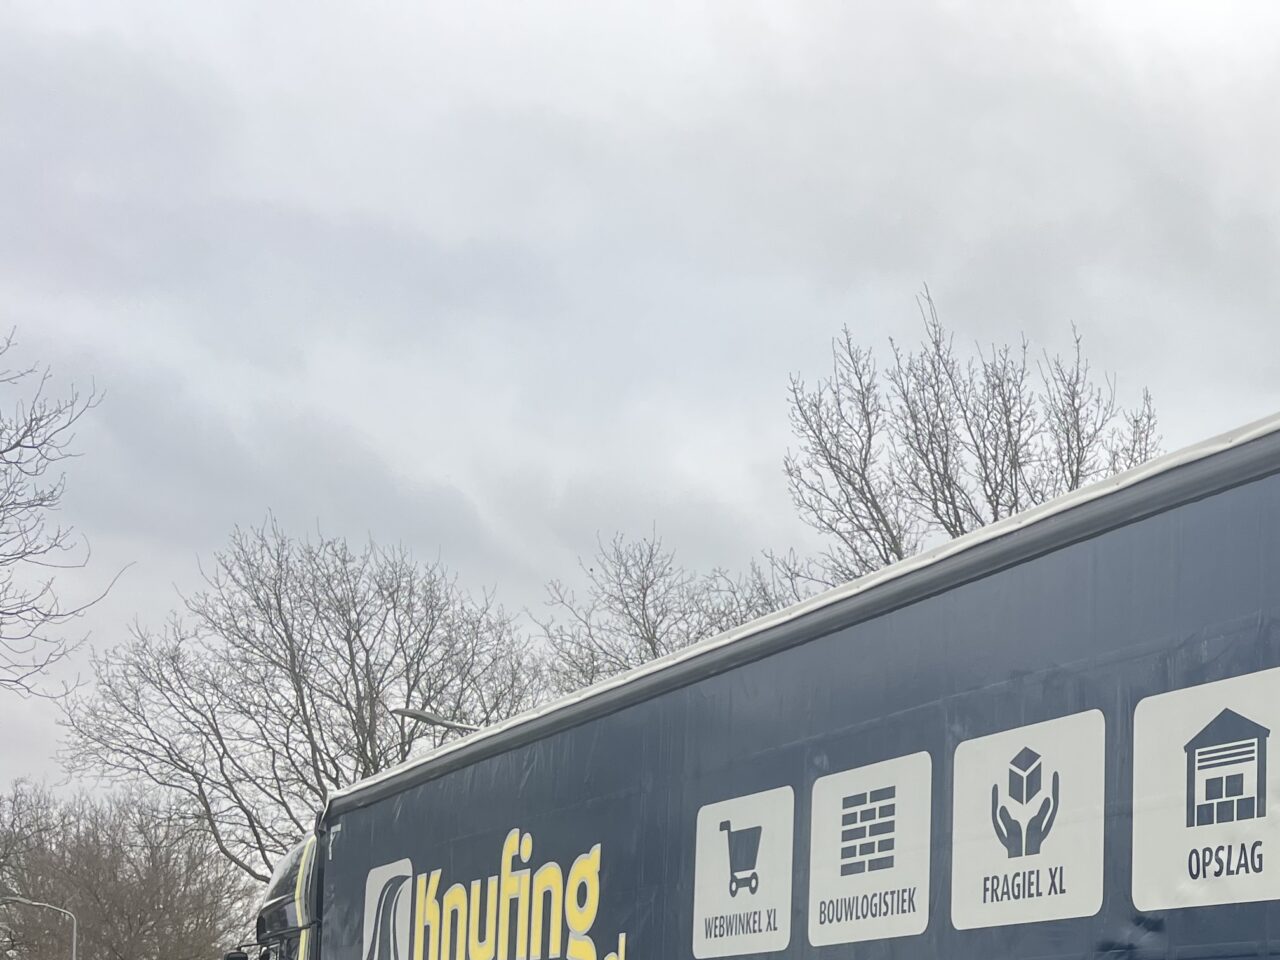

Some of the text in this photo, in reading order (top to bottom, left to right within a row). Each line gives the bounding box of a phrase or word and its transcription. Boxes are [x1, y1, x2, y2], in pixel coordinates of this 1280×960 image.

[1188, 840, 1263, 880] OPSLAG
[983, 866, 1066, 904] FRAGIEL XL
[704, 908, 778, 939] WEBWINKEL XL
[819, 887, 917, 925] BOUWLOGISTIEK
